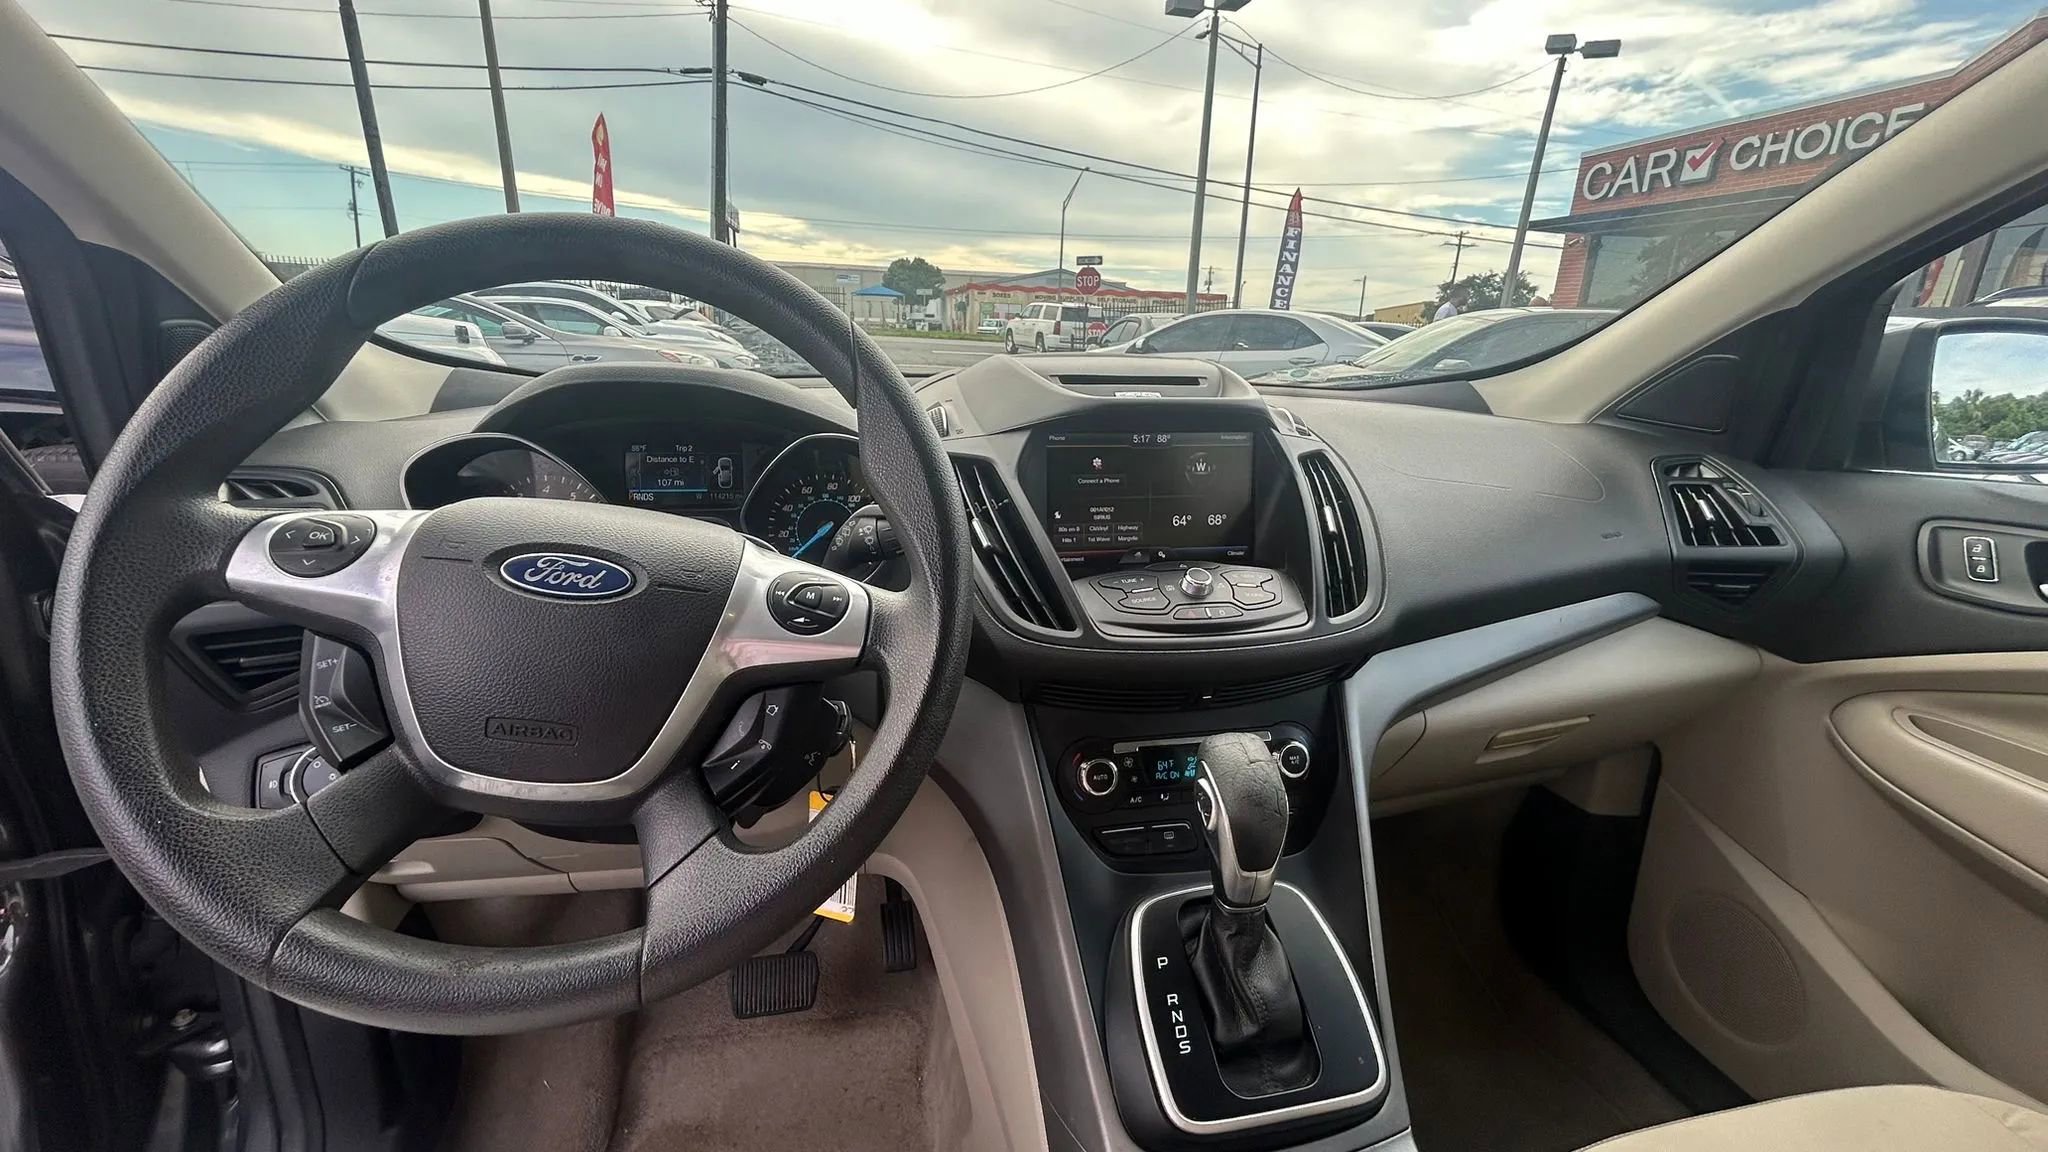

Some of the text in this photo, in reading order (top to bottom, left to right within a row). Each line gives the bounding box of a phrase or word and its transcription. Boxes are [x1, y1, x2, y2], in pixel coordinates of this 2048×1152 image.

[1582, 102, 1926, 200] CAR CHOICE
[1273, 226, 1301, 309] FINANCE
[1076, 275, 1100, 287] STOP
[1132, 434, 1151, 444] 5:17
[675, 444, 688, 453] Trip
[646, 455, 678, 463] Distance
[1195, 462, 1207, 472] W
[657, 479, 672, 487] 107
[826, 482, 839, 490] 80
[542, 485, 550, 493] 4
[801, 486, 813, 494] 60
[570, 492, 577, 500] 5
[848, 495, 861, 503] 100
[782, 504, 794, 512] 40
[308, 530, 330, 541] OK
[778, 530, 790, 538] 20
[523, 556, 607, 590] Ford
[806, 592, 815, 600] M
[491, 722, 574, 741] AIRBAG
[1155, 771, 1180, 780] A/C ON
[1129, 796, 1142, 804] A/C
[1157, 956, 1169, 969] P
[1166, 993, 1179, 1006] R
[1171, 1009, 1184, 1024] N
[1175, 1025, 1188, 1039] D
[1178, 1040, 1191, 1054] S
